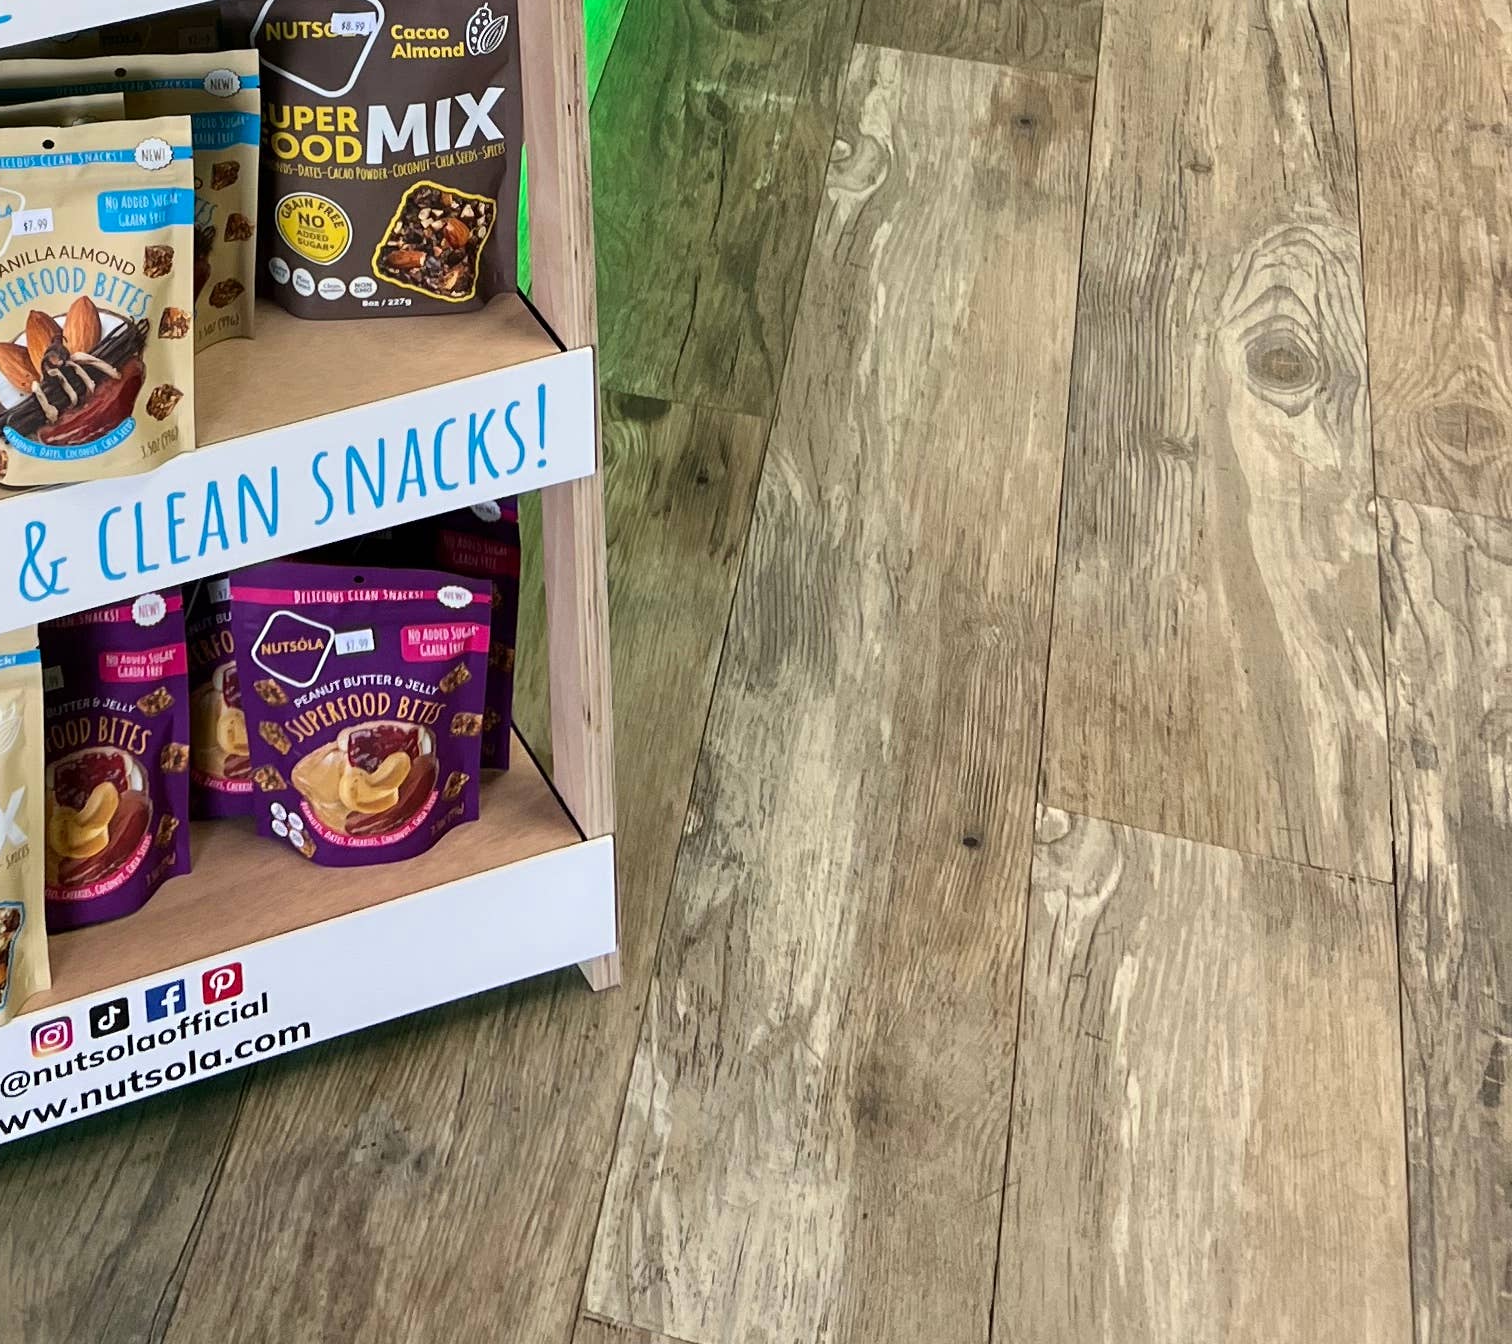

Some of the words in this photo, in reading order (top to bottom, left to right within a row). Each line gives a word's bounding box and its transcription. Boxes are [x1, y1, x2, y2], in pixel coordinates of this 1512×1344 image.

[391, 24, 449, 40] Cacao
[392, 42, 465, 59] Almond
[366, 87, 506, 165] MIX
[40, 154, 73, 168] CLEAN
[78, 151, 124, 166] SNACKS!
[23, 217, 48, 232] $7.99
[298, 213, 324, 228] NO
[59, 245, 136, 277] ALMOND
[94, 268, 152, 318] BITES
[17, 520, 66, 603] &
[261, 637, 324, 655] NUTSÓLA
[293, 679, 340, 708] PEANUT
[343, 674, 391, 689] BUTTER
[395, 675, 402, 687] &
[404, 678, 439, 696] JELLY
[285, 692, 390, 743] SUPERFOOD
[396, 695, 447, 725] BITES
[0, 991, 269, 1099] @nutsolaofficial
